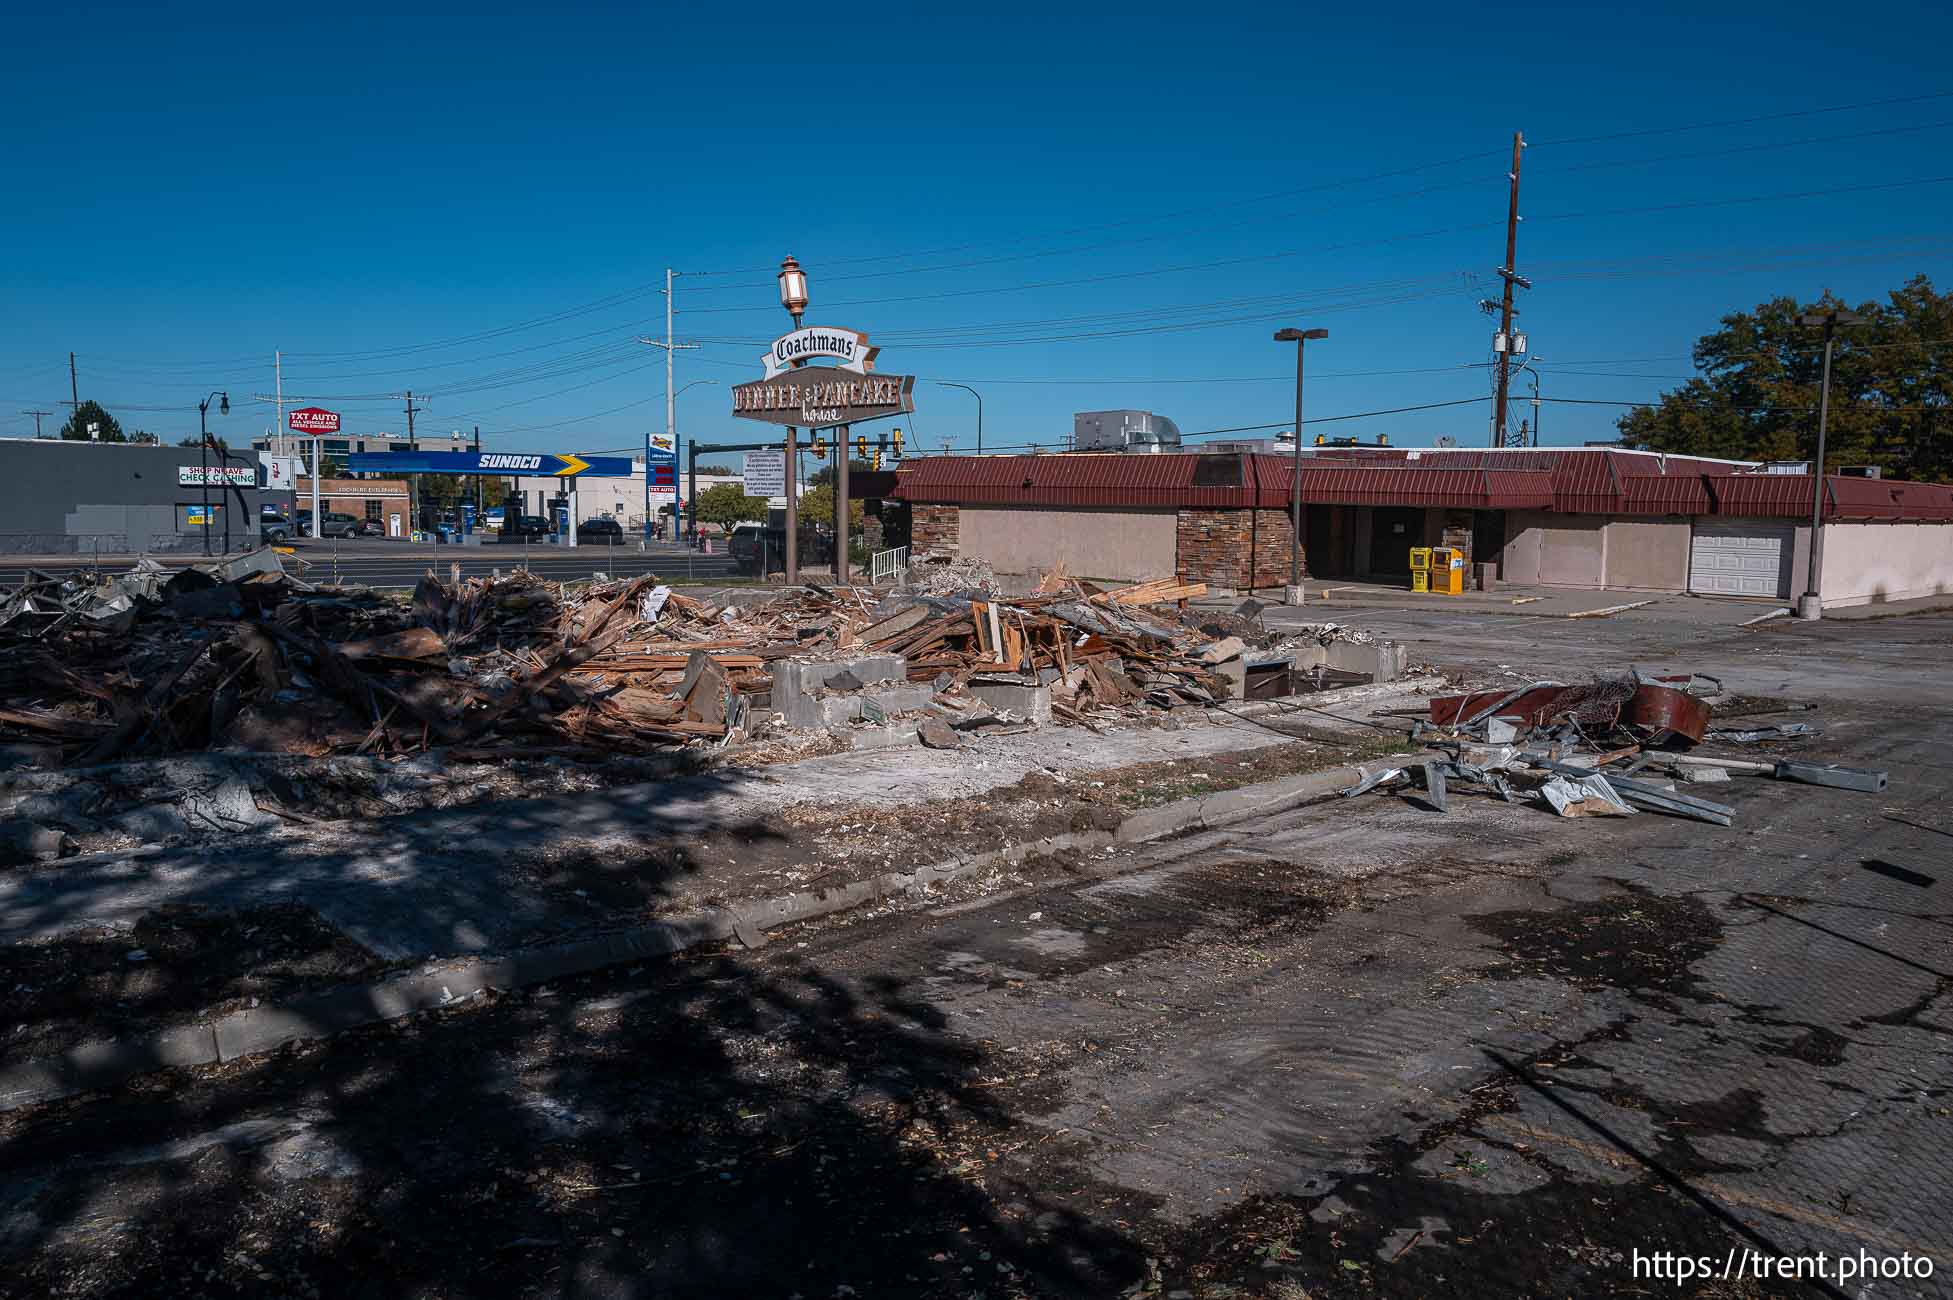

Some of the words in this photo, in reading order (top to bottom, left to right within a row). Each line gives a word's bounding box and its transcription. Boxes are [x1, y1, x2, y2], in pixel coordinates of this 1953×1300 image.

[777, 331, 853, 361] Coachmans
[734, 384, 801, 411] DINNER
[813, 380, 899, 407] PANCAKE
[802, 401, 842, 422] house
[479, 455, 541, 469] SUNOCO
